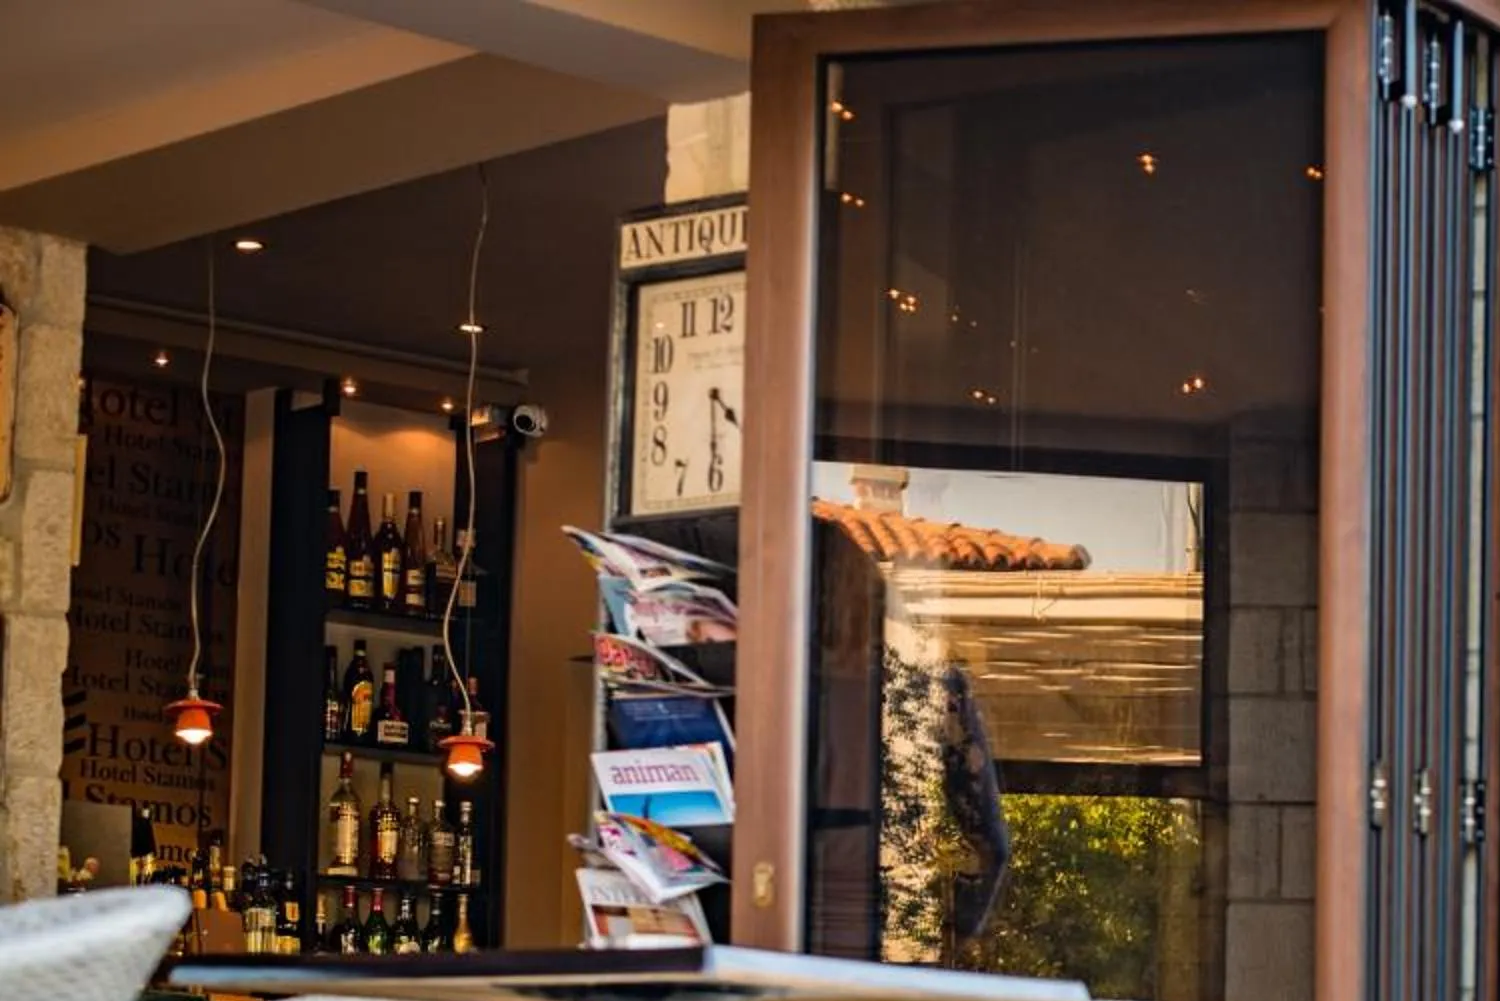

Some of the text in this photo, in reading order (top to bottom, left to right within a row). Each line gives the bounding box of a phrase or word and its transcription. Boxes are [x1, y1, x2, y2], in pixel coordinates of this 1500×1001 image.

[707, 293, 735, 335] 12
[652, 333, 675, 374] 10
[653, 381, 669, 422] 9
[651, 425, 668, 467] 8
[674, 454, 724, 497] 7 6
[89, 722, 193, 767] Hotel
[80, 758, 137, 783] Hotel
[609, 764, 701, 785] animan
